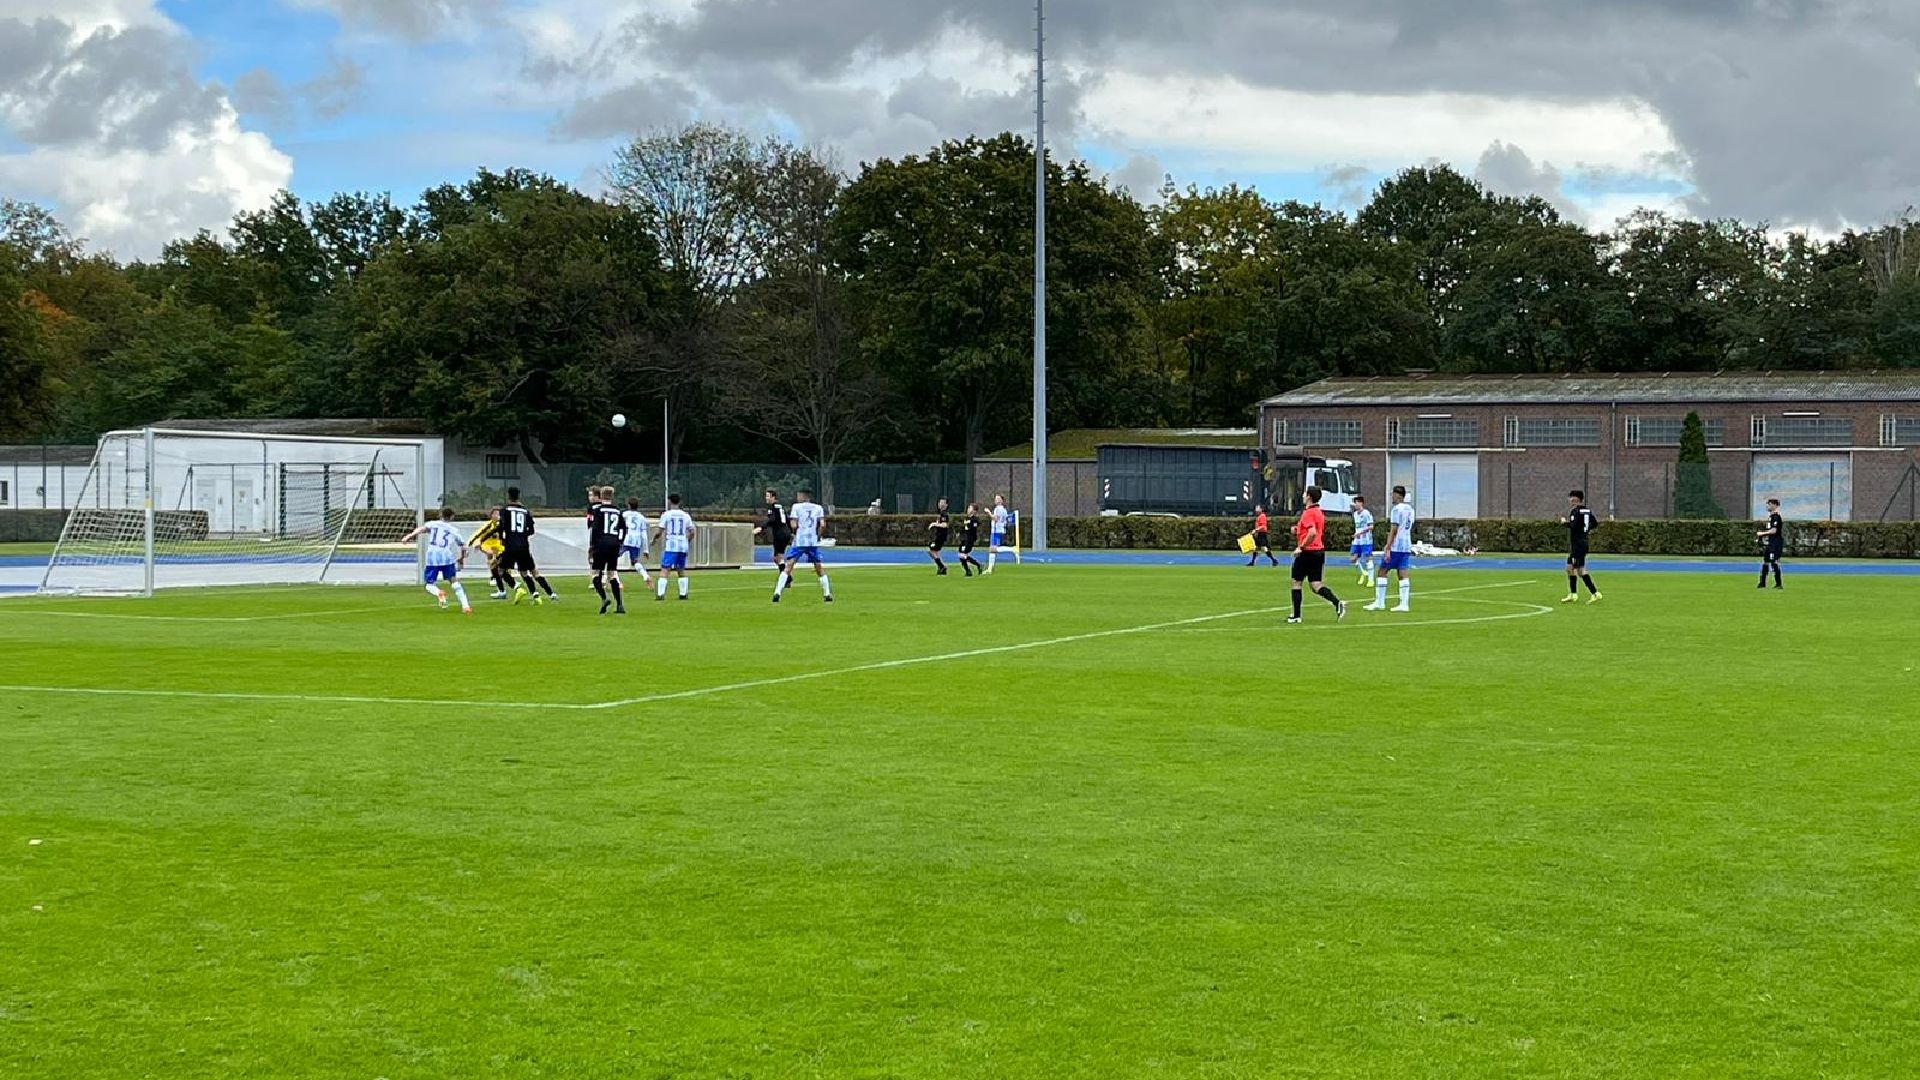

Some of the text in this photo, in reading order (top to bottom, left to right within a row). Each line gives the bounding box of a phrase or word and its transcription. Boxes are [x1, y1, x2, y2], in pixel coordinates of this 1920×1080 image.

[510, 510, 525, 532] 19
[603, 513, 619, 535] 12
[669, 518, 685, 536] 11
[430, 527, 450, 548] 13
